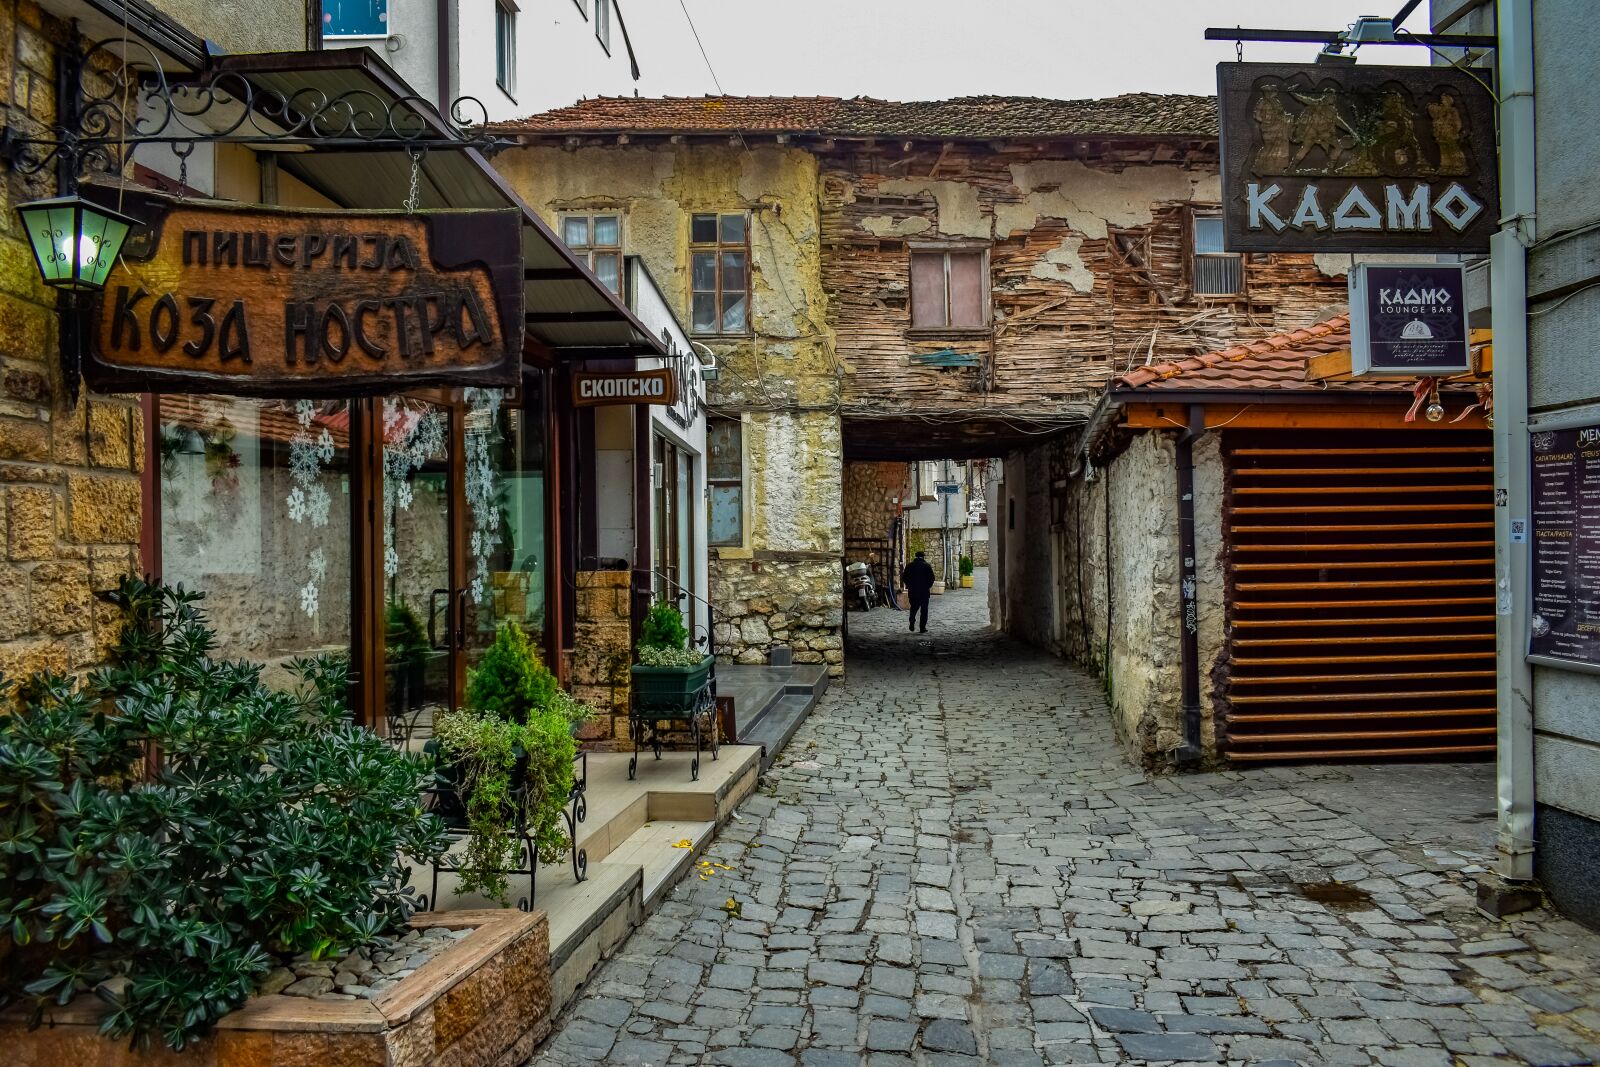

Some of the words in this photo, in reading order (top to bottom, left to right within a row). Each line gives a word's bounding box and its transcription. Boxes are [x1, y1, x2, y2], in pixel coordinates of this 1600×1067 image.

[183, 229, 422, 271] ПИЦЕРИЈА
[111, 286, 253, 363] КОЗА
[285, 286, 493, 363] НОСТРА
[1380, 306, 1425, 314] LOUNGE
[580, 377, 664, 397] СКОПСКО
